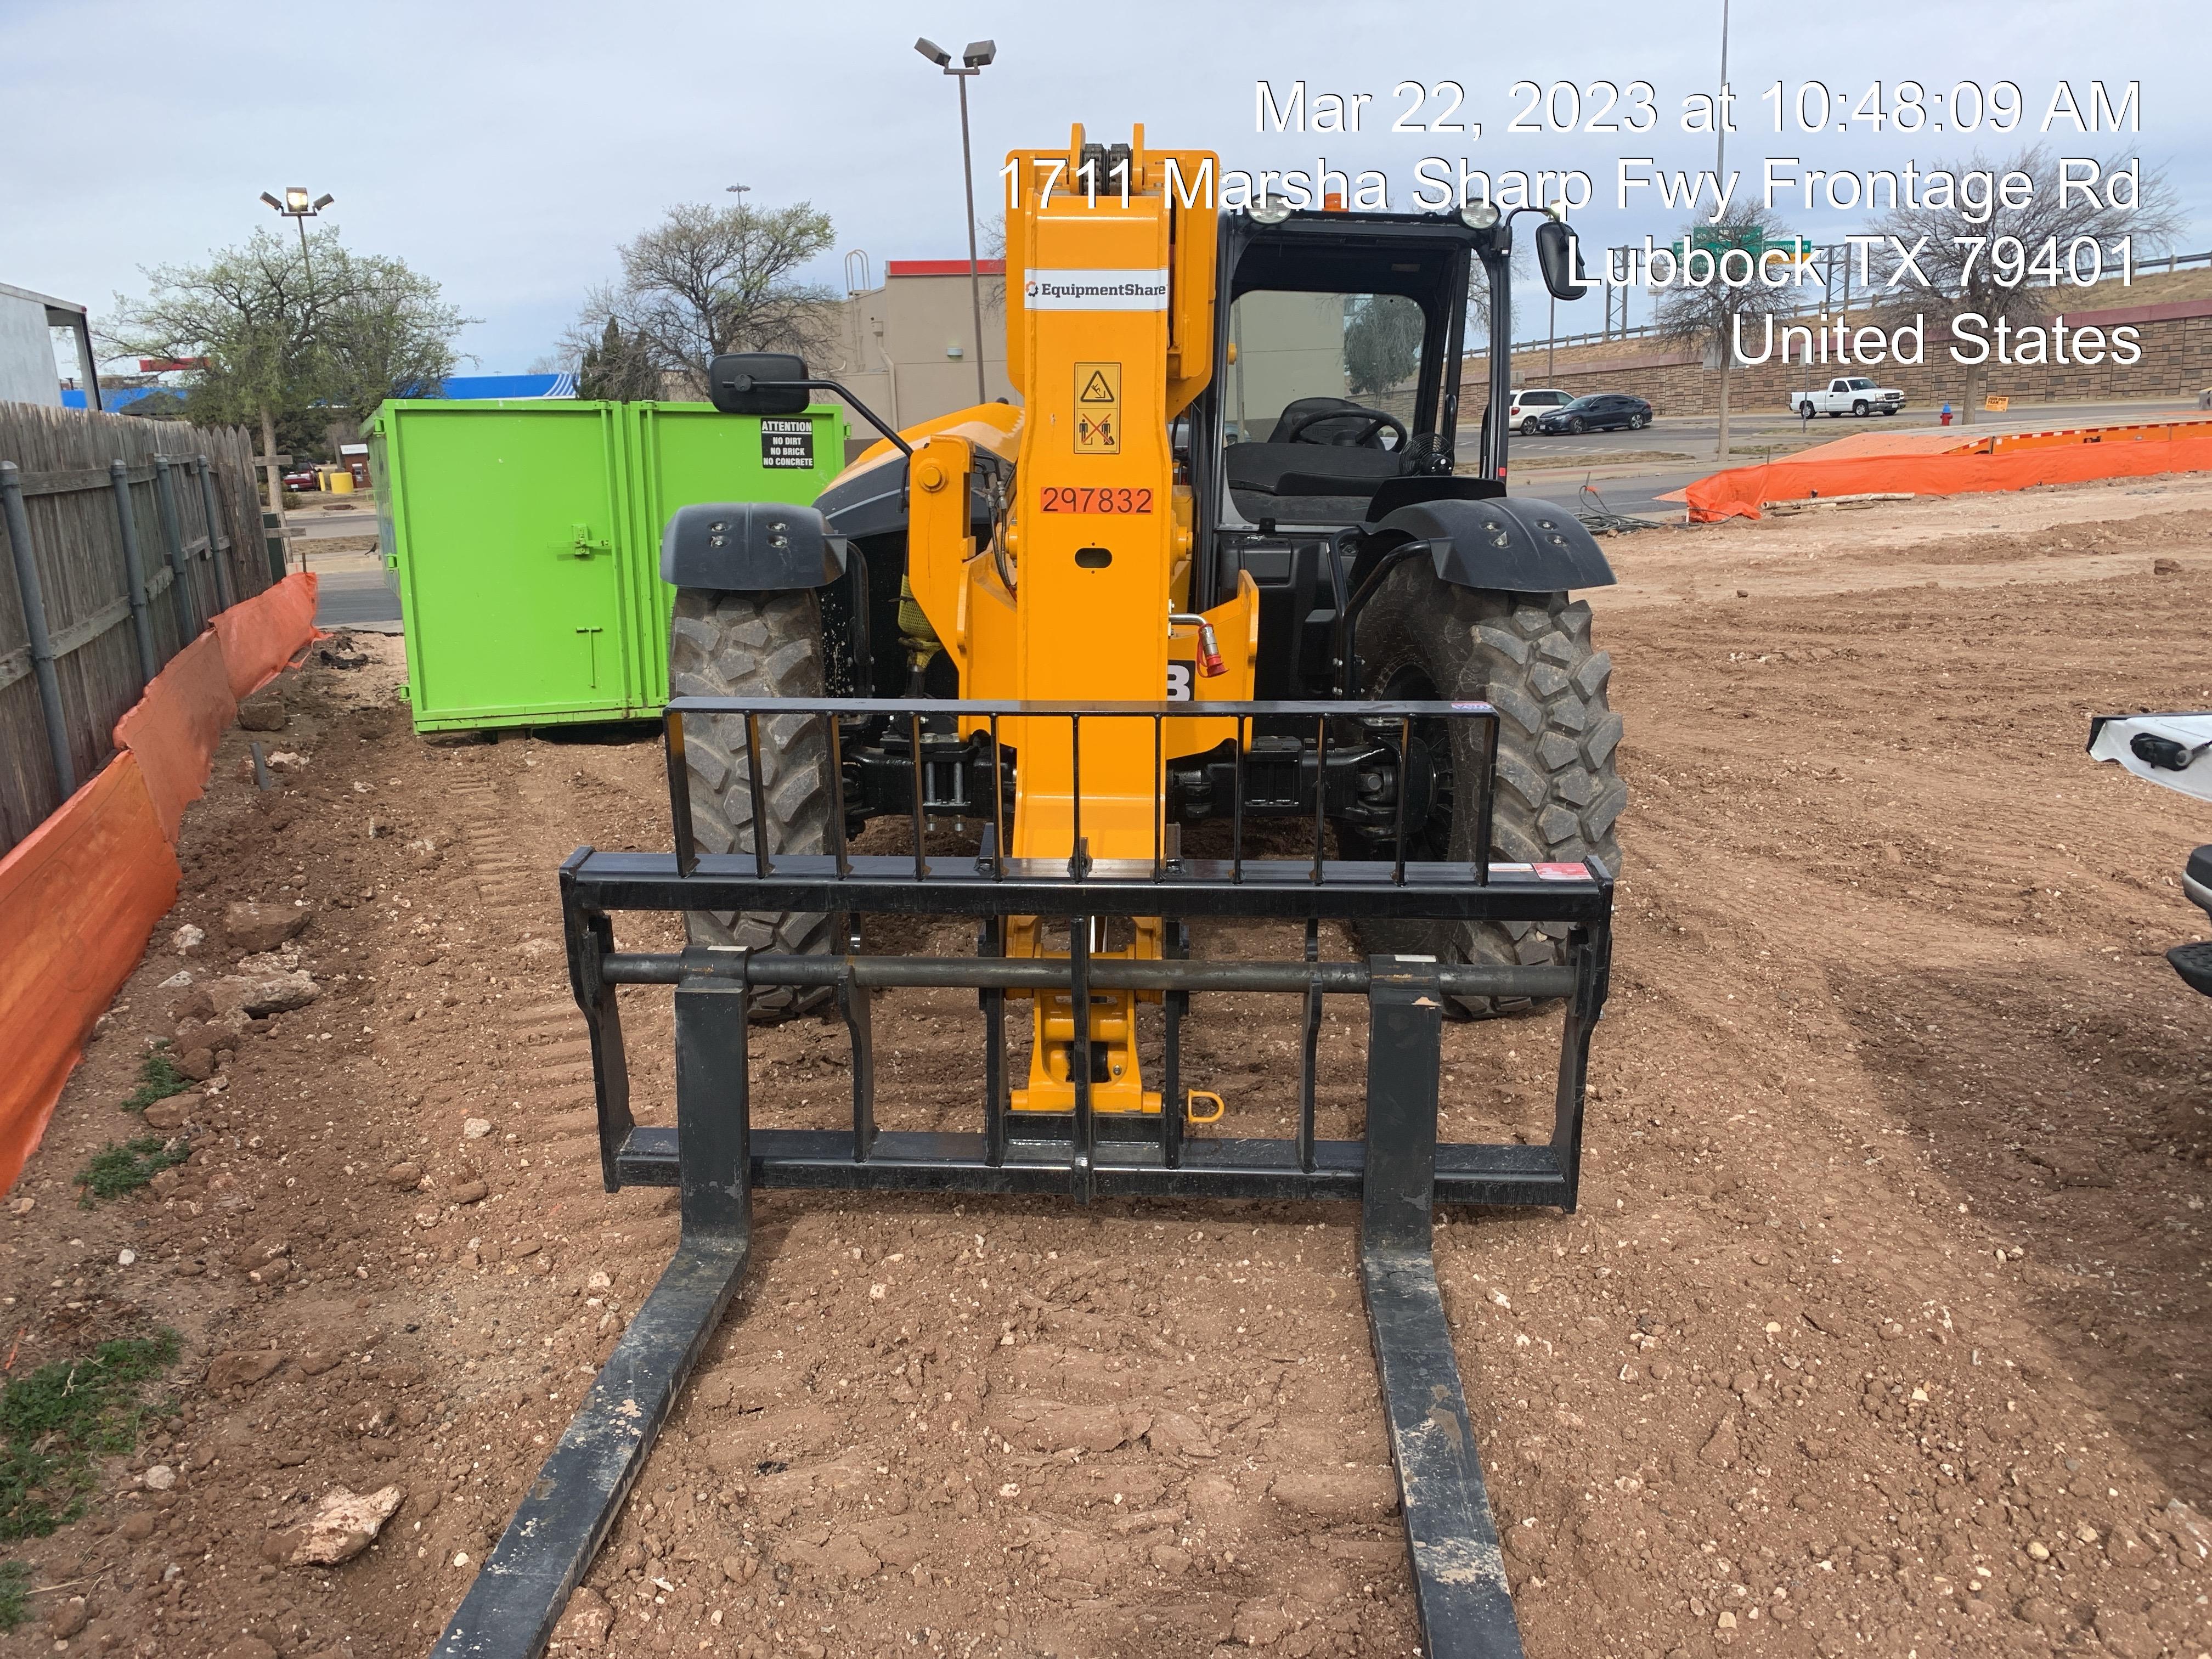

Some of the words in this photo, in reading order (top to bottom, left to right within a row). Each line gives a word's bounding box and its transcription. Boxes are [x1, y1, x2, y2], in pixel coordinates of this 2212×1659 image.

[1041, 283, 1166, 298] EquipmentShare
[761, 421, 812, 432] ATTENTION
[772, 437, 783, 445] NO
[785, 437, 802, 445] DIRT
[770, 447, 781, 455] NO
[782, 447, 805, 455] BRICK
[763, 457, 774, 466] NO
[775, 458, 813, 466] CONCRETE
[1043, 487, 1152, 513] 297832
